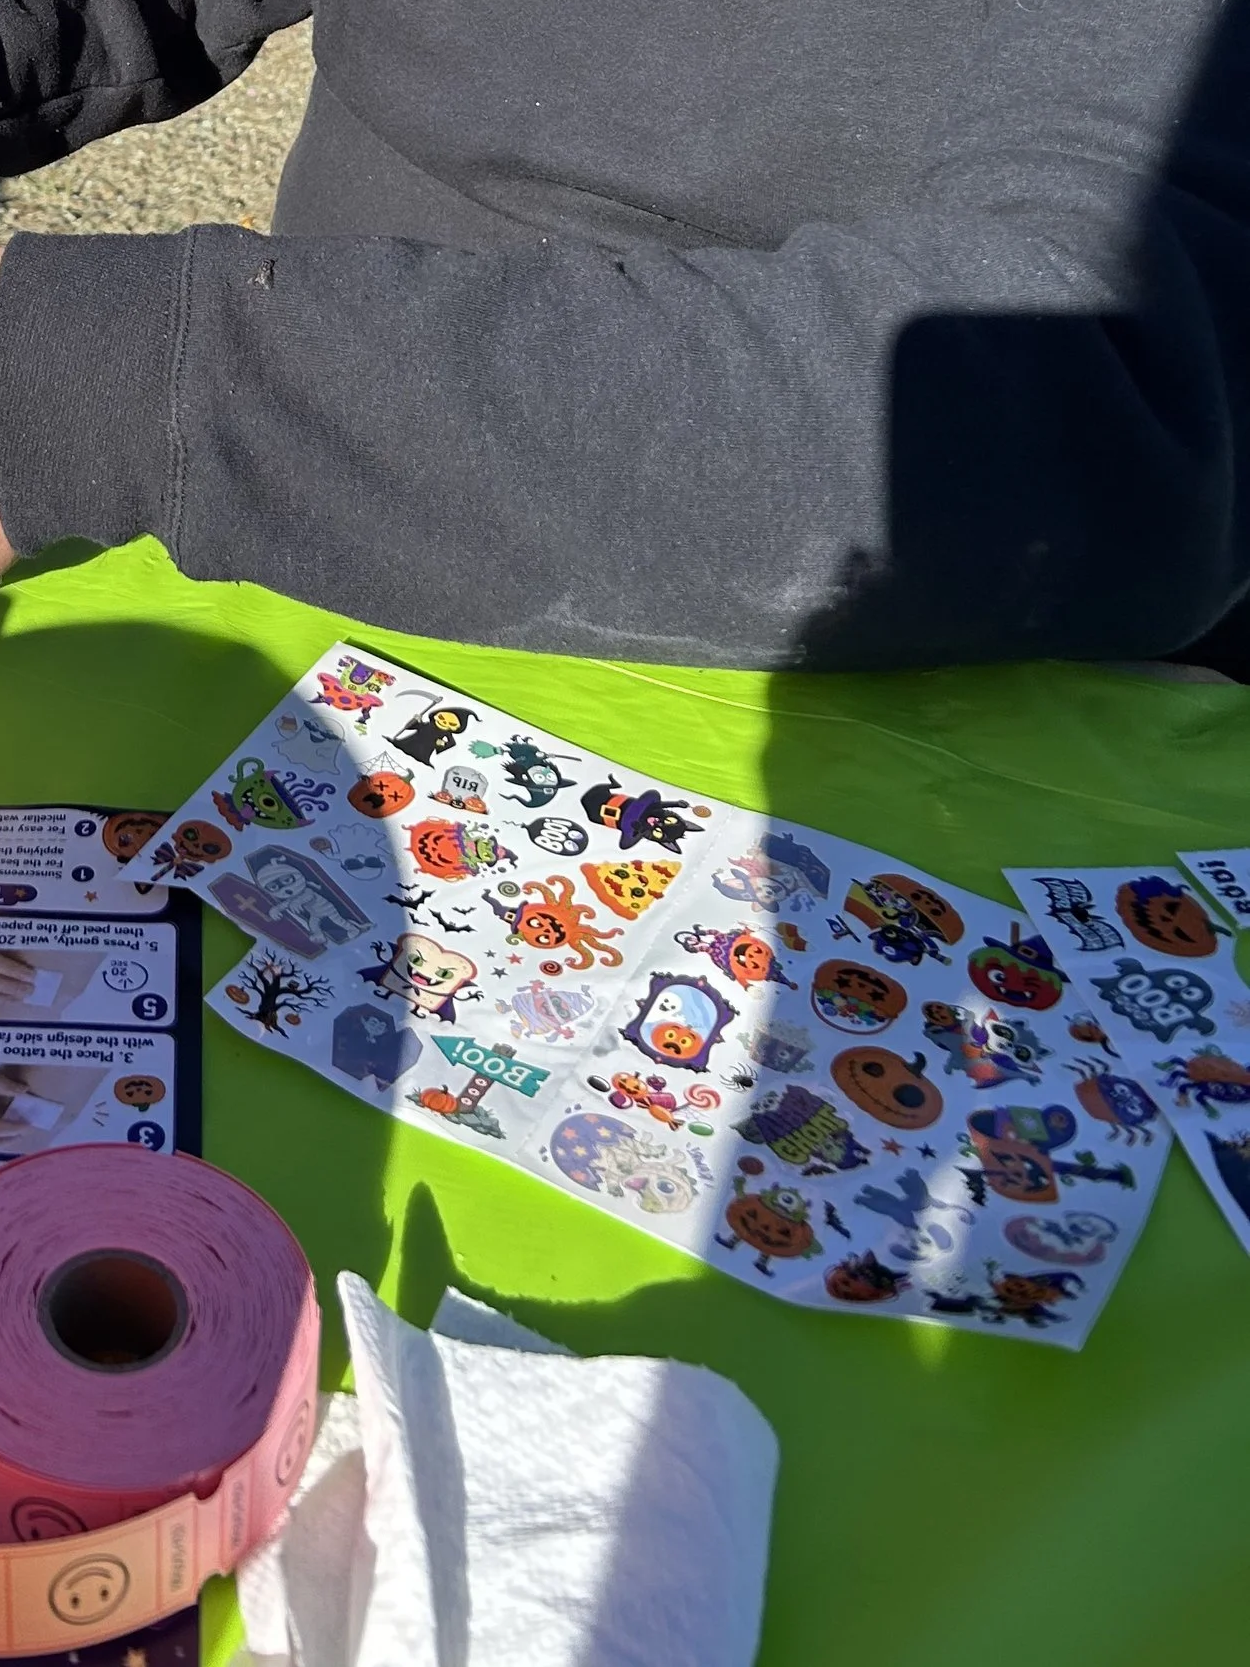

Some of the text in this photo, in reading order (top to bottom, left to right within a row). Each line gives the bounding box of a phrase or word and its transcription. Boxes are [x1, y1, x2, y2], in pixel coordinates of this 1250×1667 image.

[23, 814, 66, 823] micellar
[17, 823, 41, 833] easy
[44, 824, 65, 835] For
[81, 823, 89, 834] 2
[17, 846, 64, 856] applying
[23, 858, 41, 867] the
[45, 858, 63, 868] For
[79, 869, 87, 879] 1
[36, 923, 57, 934] the
[61, 924, 80, 934] off
[83, 924, 110, 936] peel
[114, 926, 144, 937] then
[21, 935, 49, 945] wait
[53, 934, 99, 947] gently,
[104, 938, 140, 951] Press
[144, 941, 158, 952] 5.
[111, 967, 128, 976] 20
[142, 997, 157, 1017] 5
[15, 1032, 43, 1044] side
[47, 1032, 91, 1046] design
[94, 1036, 119, 1048] the
[123, 1037, 154, 1049] with
[3, 1045, 46, 1058] tattoo
[50, 1048, 72, 1060] the
[75, 1048, 114, 1062] Place
[118, 1051, 134, 1063] 3.
[138, 1125, 155, 1148] 3
